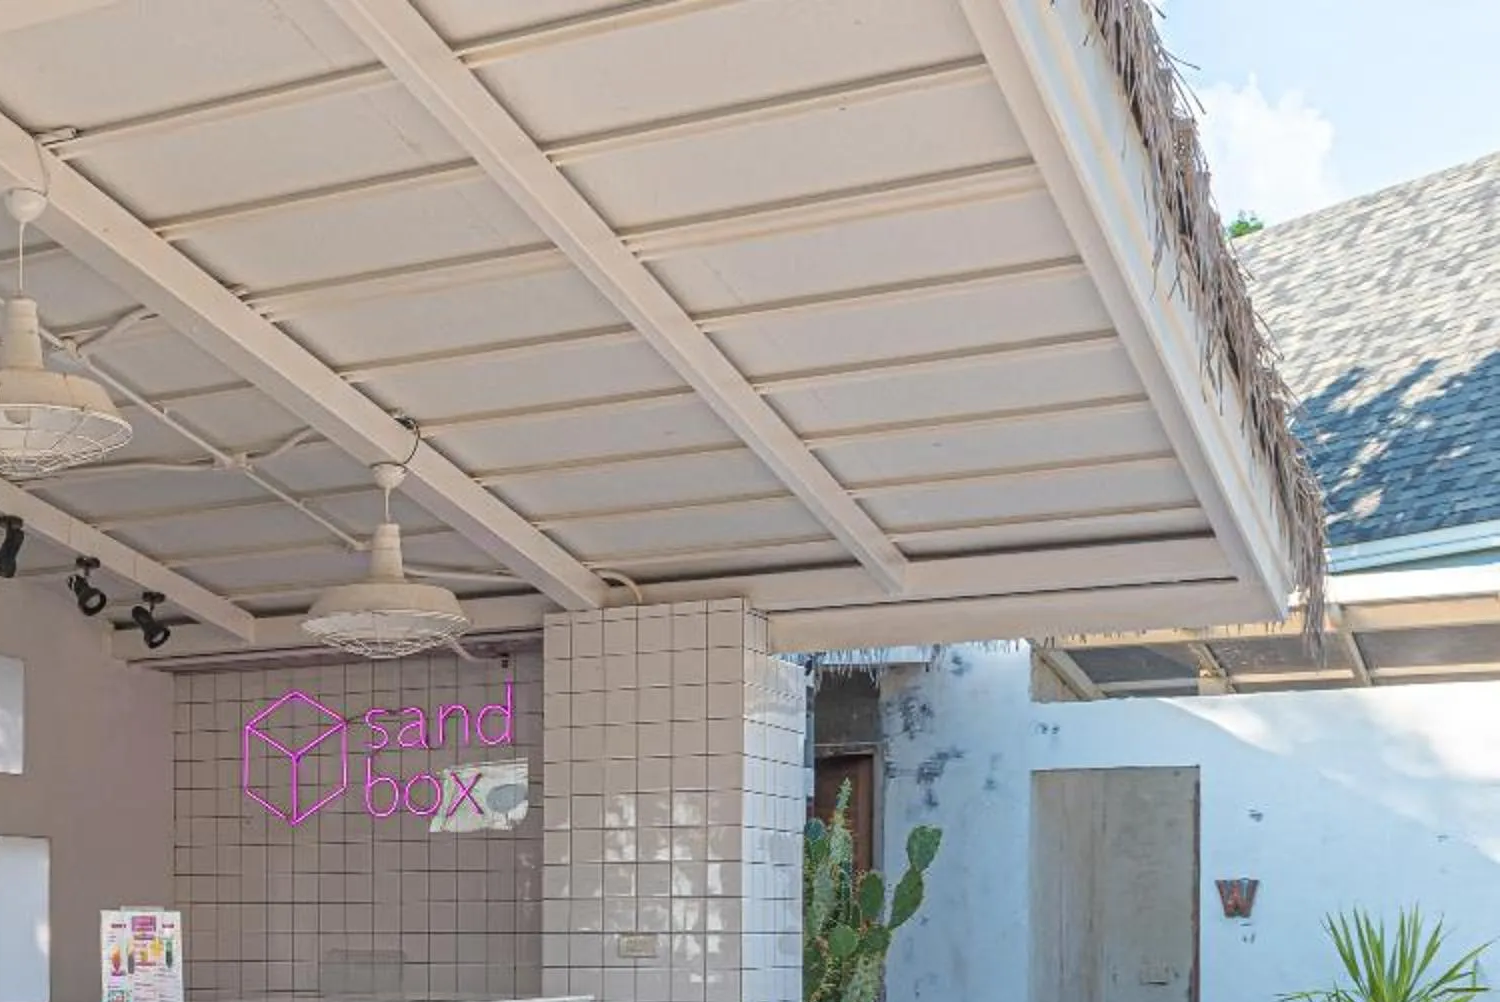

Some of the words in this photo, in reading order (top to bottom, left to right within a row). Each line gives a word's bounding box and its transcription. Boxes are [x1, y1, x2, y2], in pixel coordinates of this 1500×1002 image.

[363, 675, 514, 750] sand
[363, 756, 484, 818] box
[1214, 878, 1260, 920] W
